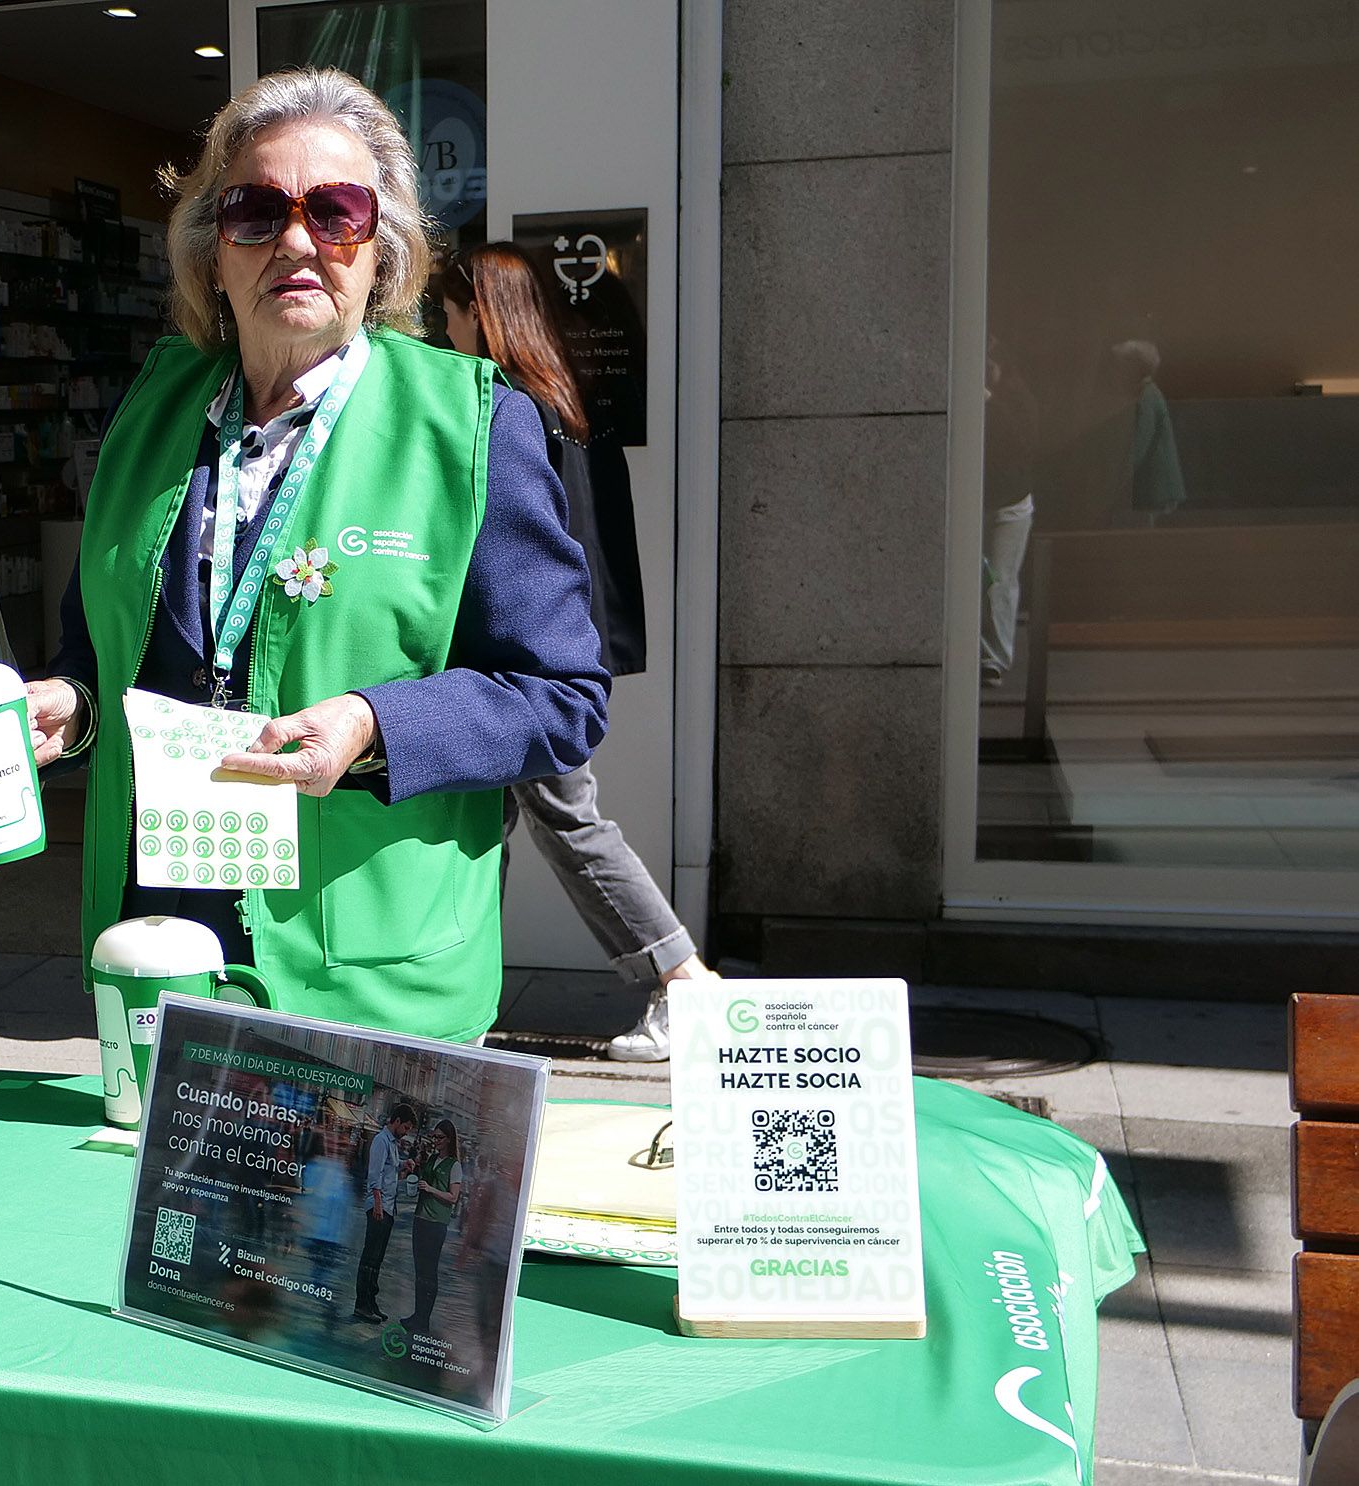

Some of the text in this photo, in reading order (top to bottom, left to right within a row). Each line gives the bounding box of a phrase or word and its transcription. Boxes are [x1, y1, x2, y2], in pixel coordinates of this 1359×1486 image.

[372, 548, 399, 556] contra
[765, 1002, 813, 1010] asociación
[136, 1013, 155, 1025] 20
[765, 1012, 807, 1022] española
[766, 1021, 839, 1030] contra el cáncer
[719, 1047, 861, 1063] HAZTE SOCIO
[190, 1048, 364, 1090] 7 DE MAYO DÍA DE LA CUESTACIÓN
[721, 1073, 862, 1089] HAZTE SOCIA
[176, 1082, 301, 1127] Cuando paras,
[172, 1110, 292, 1149] nos movemos
[168, 1135, 306, 1178] contra el cáncer
[162, 1180, 229, 1203] apoyo y esperanza
[164, 1166, 293, 1205] Tu aportación mueve investigación,
[714, 1225, 880, 1235] Entre todos y todas conseguiremos
[697, 1238, 733, 1247] superar
[735, 1236, 745, 1244] el
[746, 1237, 758, 1245] 70
[760, 1237, 768, 1245] %
[770, 1236, 783, 1245] de
[784, 1237, 851, 1246] supervivencia
[867, 1237, 900, 1245] cáncer
[237, 1249, 266, 1265] Bizum
[149, 1261, 181, 1281] Dona
[750, 1259, 850, 1276] GRACIAS
[234, 1264, 333, 1301] Con el código 06483
[147, 1280, 235, 1311] dona.contraelcancer.es
[983, 1250, 1050, 1352] asociación
[413, 1334, 452, 1350] asociación
[412, 1344, 446, 1358] española
[411, 1353, 471, 1375] contra el cáncer
